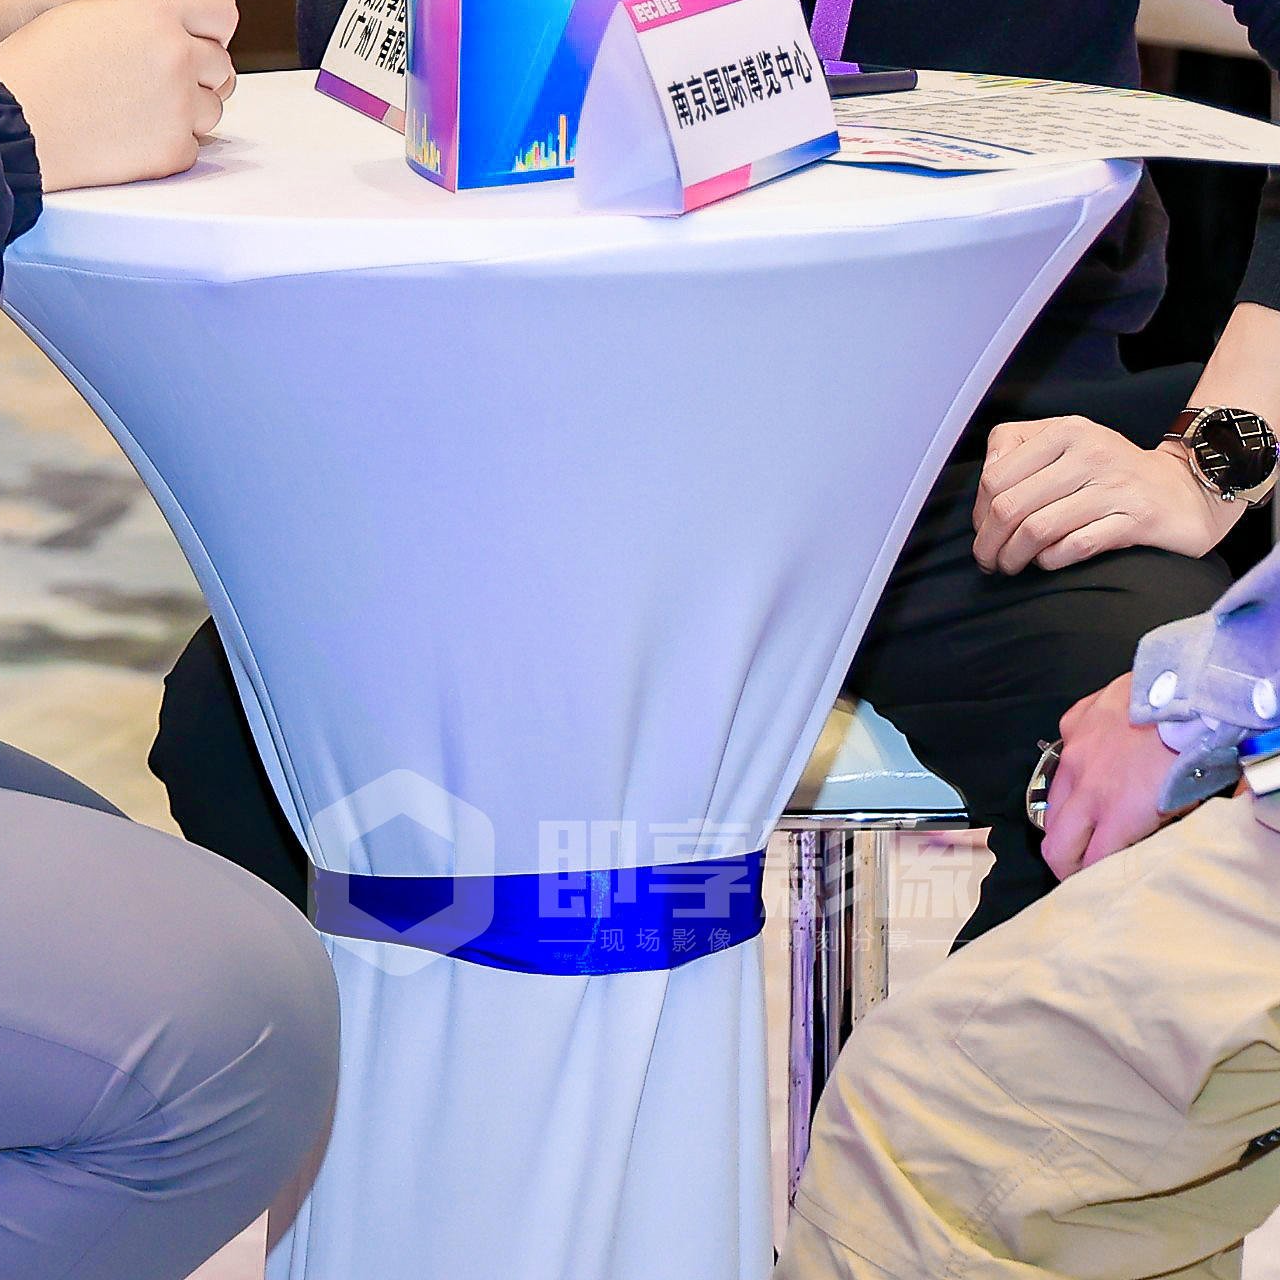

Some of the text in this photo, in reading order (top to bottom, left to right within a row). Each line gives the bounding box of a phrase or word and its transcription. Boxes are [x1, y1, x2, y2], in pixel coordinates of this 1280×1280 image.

[666, 39, 814, 130] 南京国际博览中心
